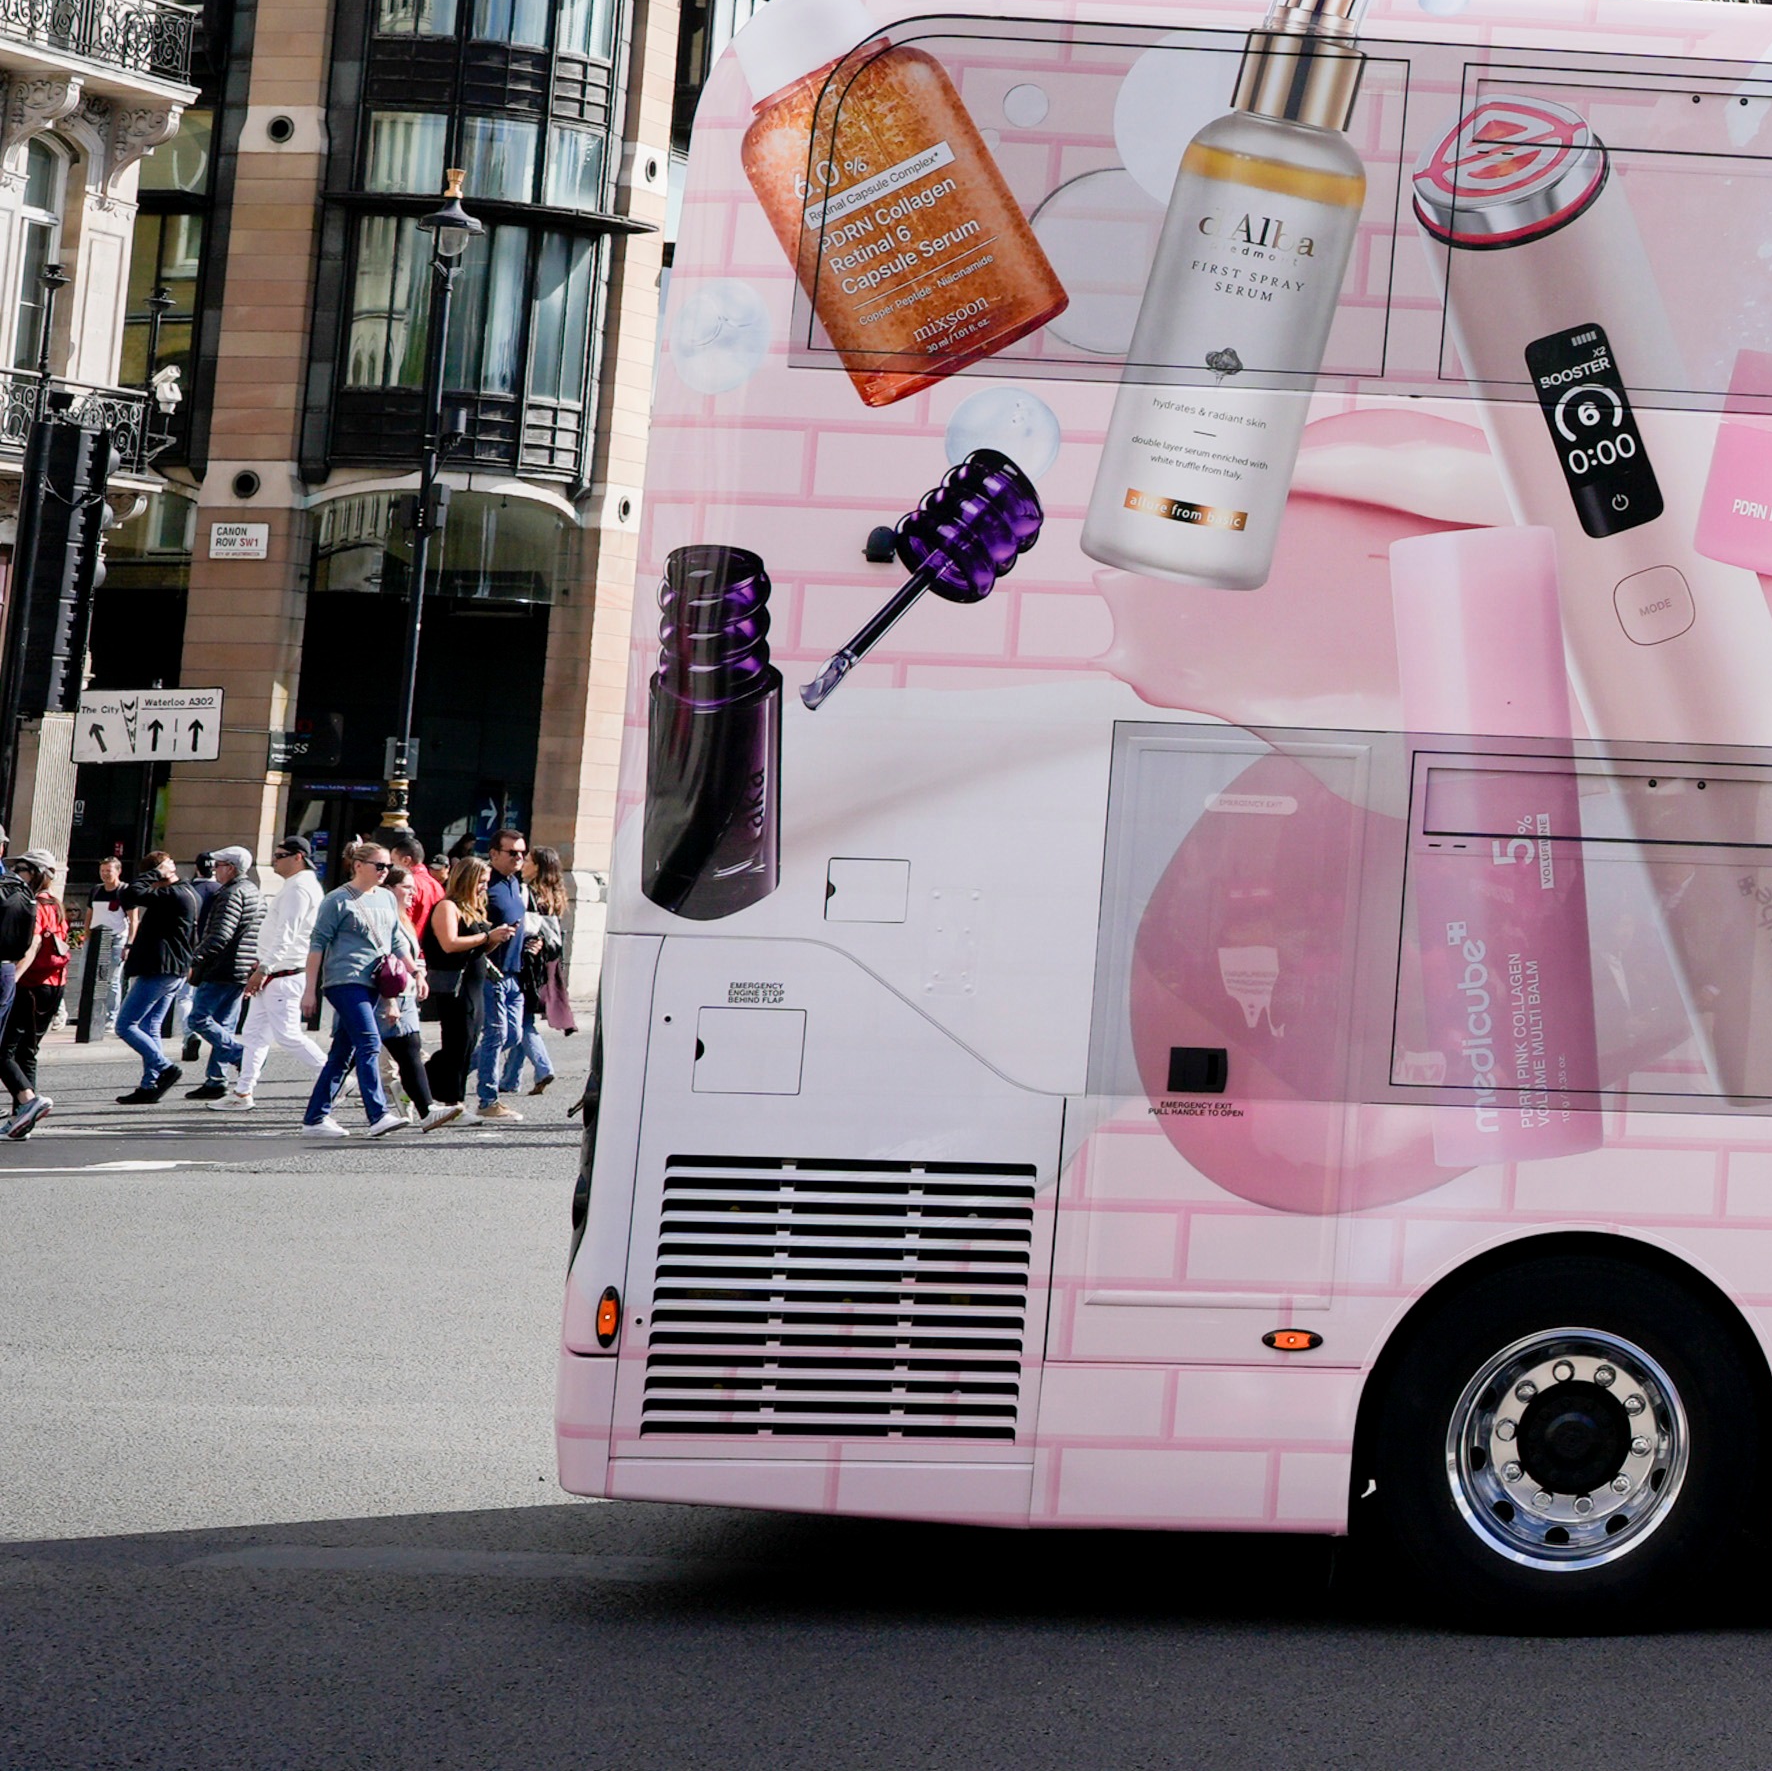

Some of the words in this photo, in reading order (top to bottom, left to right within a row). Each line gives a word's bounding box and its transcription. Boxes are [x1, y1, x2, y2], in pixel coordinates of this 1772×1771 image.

[846, 179, 889, 205] Capsule
[817, 216, 874, 254] PDRN
[875, 177, 957, 226] Collagen
[829, 233, 894, 275] Retinal
[896, 225, 911, 242] 6
[841, 251, 919, 295] Capsule
[919, 220, 981, 258] Serum
[860, 305, 895, 326] Copper
[895, 287, 933, 308] Peptide
[937, 254, 993, 287] Niacinamide
[1192, 260, 1241, 279] FIRST
[1249, 272, 1305, 292] SPRAY
[1214, 281, 1273, 302] SERUM
[913, 296, 989, 342] mixsoon
[1540, 356, 1611, 389] BOOSTER
[1152, 397, 1196, 417] hydrates
[1207, 409, 1243, 425] radiant
[1246, 417, 1266, 429] skin
[1577, 401, 1601, 426] 6
[1131, 434, 1162, 449] double
[1184, 446, 1210, 458] serum
[1211, 449, 1249, 467] enriched
[1249, 458, 1268, 470] with
[1150, 453, 1174, 467] white
[1202, 463, 1222, 476] from
[1568, 433, 1636, 474] 0:00
[1171, 503, 1203, 521] from
[1206, 510, 1242, 528] basic
[1732, 498, 1767, 522] PDRN
[215, 538, 237, 547] ROW
[239, 538, 258, 547] SW1
[216, 526, 247, 536] CANON
[1638, 598, 1673, 617] MODE
[81, 706, 97, 714] The
[101, 705, 119, 715] City
[144, 698, 186, 707] Waterloo
[188, 696, 214, 706] A302
[728, 989, 761, 997] ENGINE
[762, 989, 785, 997] STOP
[1508, 953, 1527, 1039] COLLAGEN
[1526, 959, 1542, 1005] BALM
[728, 996, 760, 1004] BEHIND
[1457, 939, 1499, 1133] medicube
[1529, 1011, 1545, 1055] MULTI
[1514, 1040, 1528, 1080] PINK
[1160, 1101, 1213, 1109] EMERGENCY
[1518, 1082, 1535, 1128] PDRN
[1532, 1059, 1551, 1128] VOLUME
[1220, 1109, 1244, 1117] OPEN
